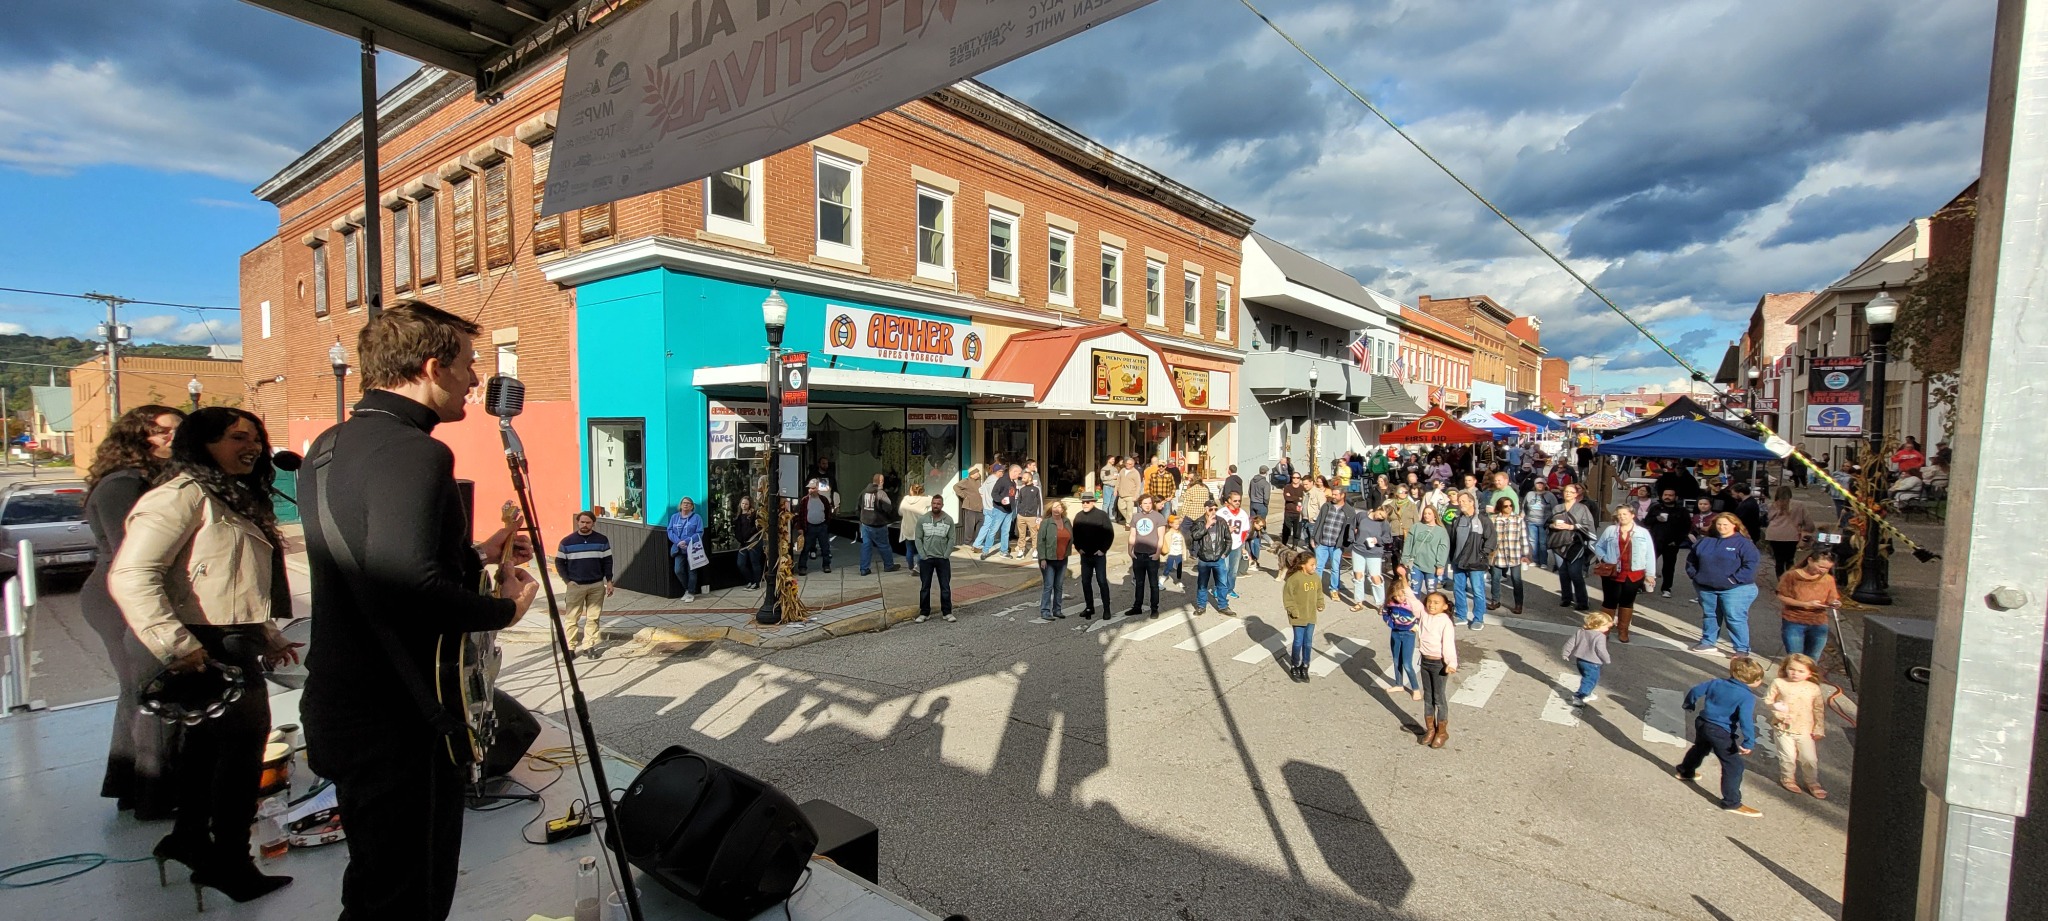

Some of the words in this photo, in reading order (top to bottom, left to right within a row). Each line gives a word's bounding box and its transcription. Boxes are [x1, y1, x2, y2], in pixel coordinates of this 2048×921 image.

[867, 313, 954, 356] AETHER
[878, 350, 901, 359] VAPES
[910, 352, 944, 363] TOBACCO
[739, 434, 762, 443] VAPOR
